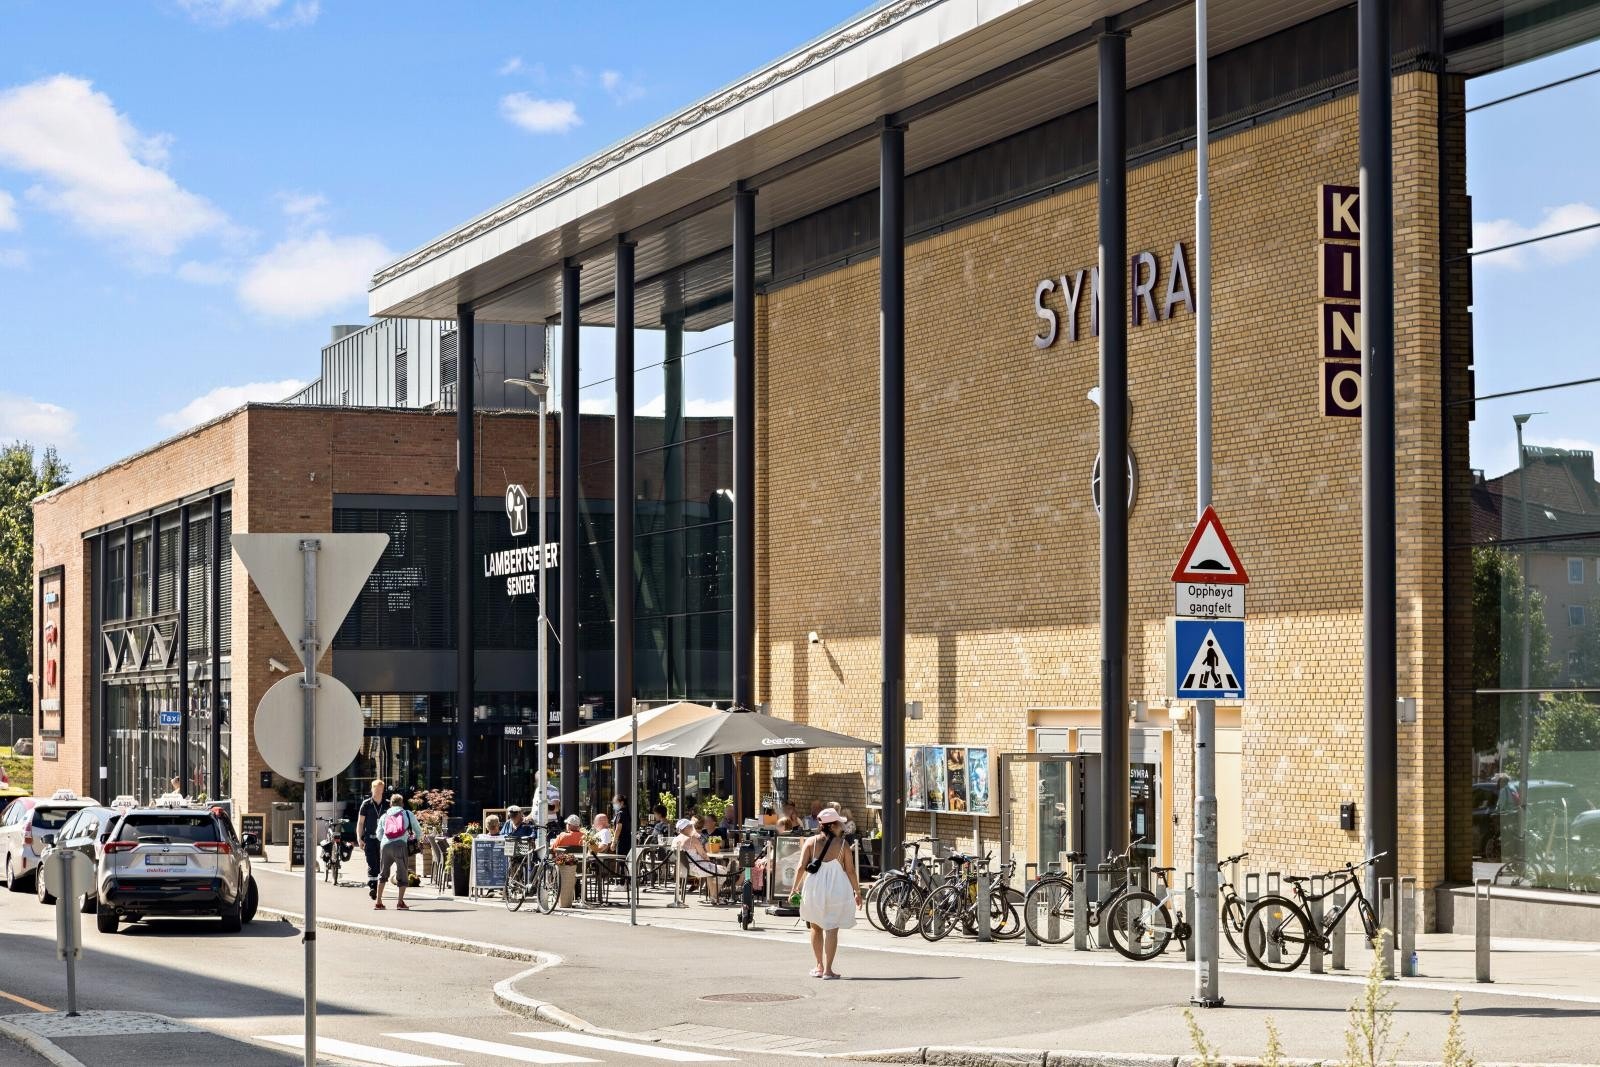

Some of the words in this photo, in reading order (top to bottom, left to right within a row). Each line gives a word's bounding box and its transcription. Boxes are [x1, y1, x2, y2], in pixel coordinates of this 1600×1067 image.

[1034, 240, 1196, 350] SYRA
[1331, 192, 1361, 411] KINO
[484, 542, 558, 577] LAMBERTSEER
[507, 574, 535, 596] SENTER
[1188, 585, 1233, 600] Opphøyd
[1189, 602, 1232, 615] gangfelt
[161, 713, 180, 723] Taxi
[1130, 769, 1149, 779] SYMRA
